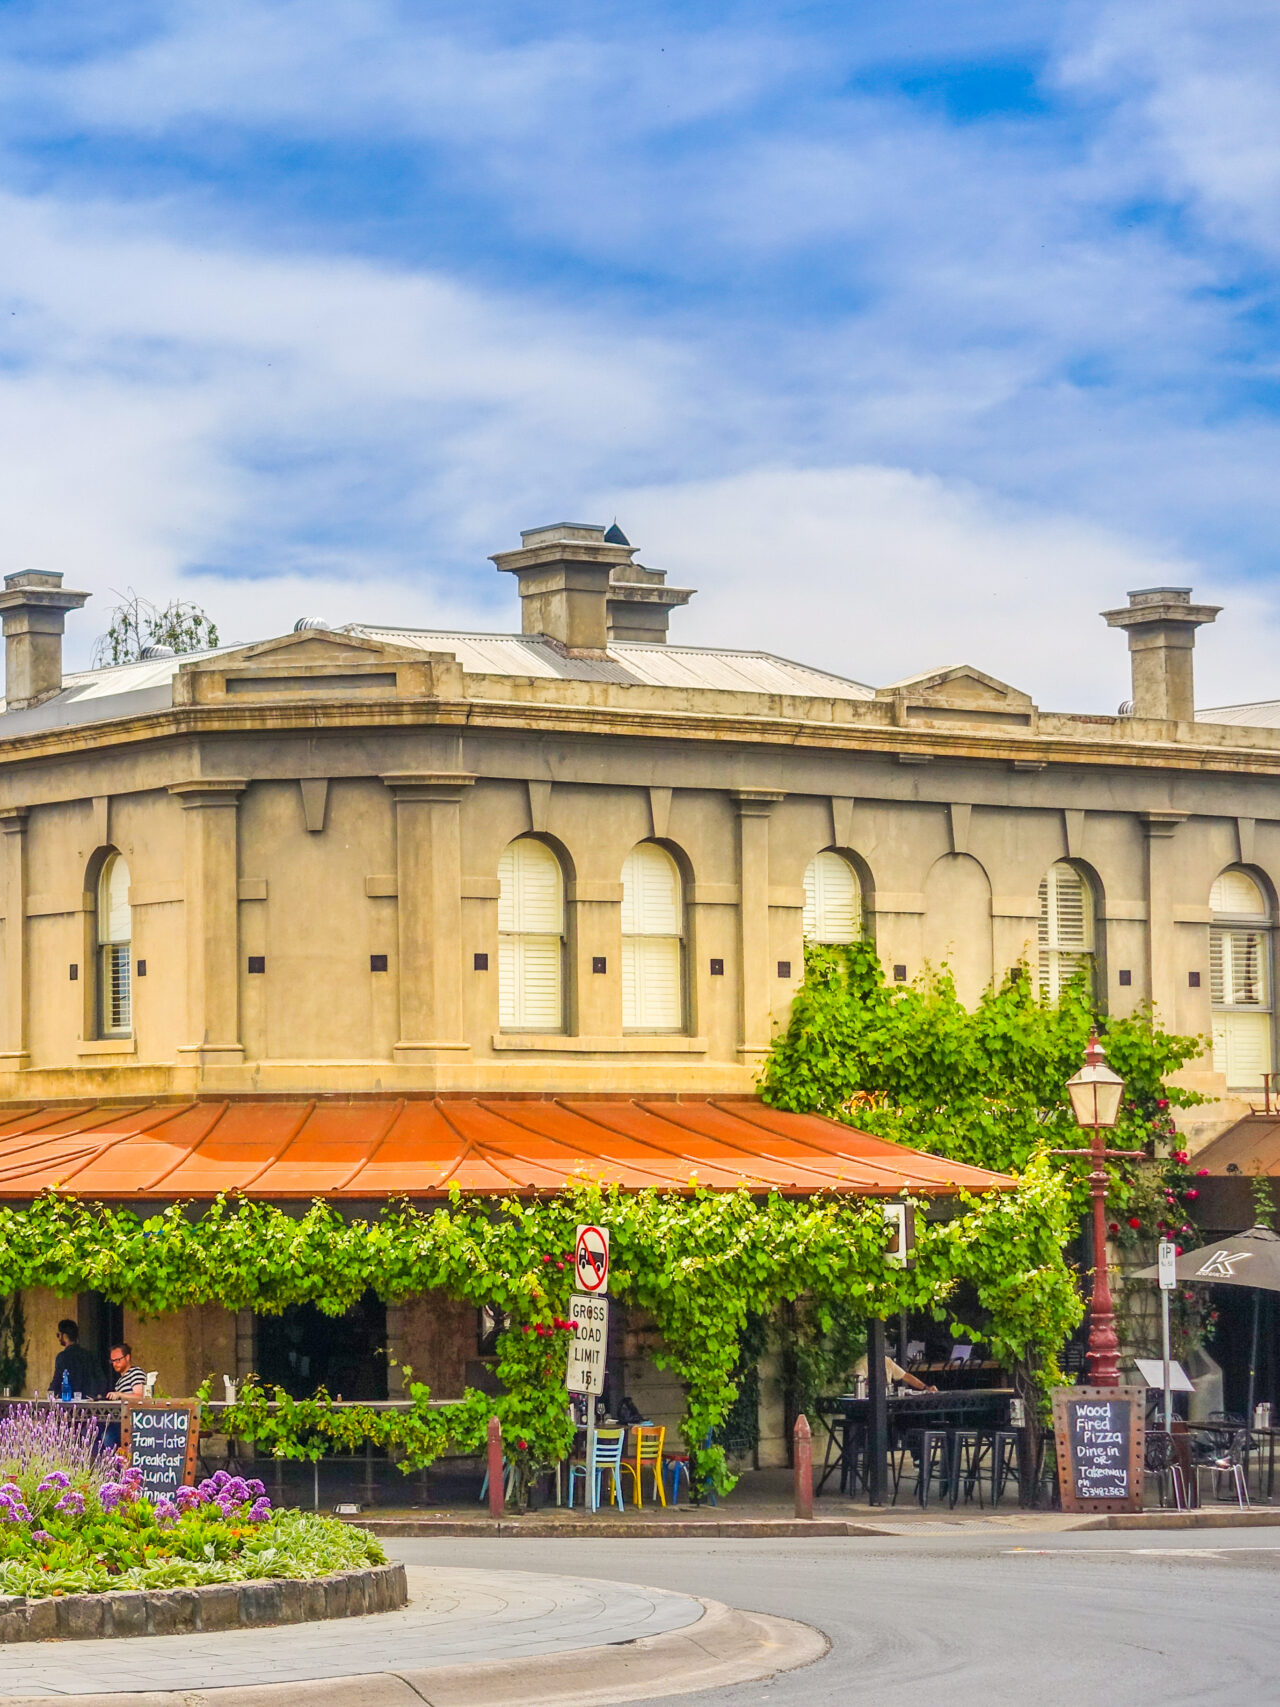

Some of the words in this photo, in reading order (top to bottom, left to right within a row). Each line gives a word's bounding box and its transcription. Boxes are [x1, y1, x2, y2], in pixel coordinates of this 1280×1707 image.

[573, 1304, 605, 1321] GROSS
[575, 1326, 602, 1343] LOAD
[574, 1347, 600, 1364] LIMIT
[581, 1370, 592, 1384] 15
[594, 1378, 597, 1386] t
[1076, 1403, 1111, 1417] Wood
[132, 1412, 188, 1431] Koukla
[1077, 1417, 1110, 1432] Fired
[1084, 1431, 1122, 1444] Pizza
[132, 1452, 184, 1467] Breakfast
[1077, 1446, 1106, 1457] Dine
[1107, 1446, 1119, 1456] in
[142, 1467, 177, 1485] Lunch
[1079, 1466, 1126, 1486] Takeaway
[1082, 1487, 1125, 1497] 53482363
